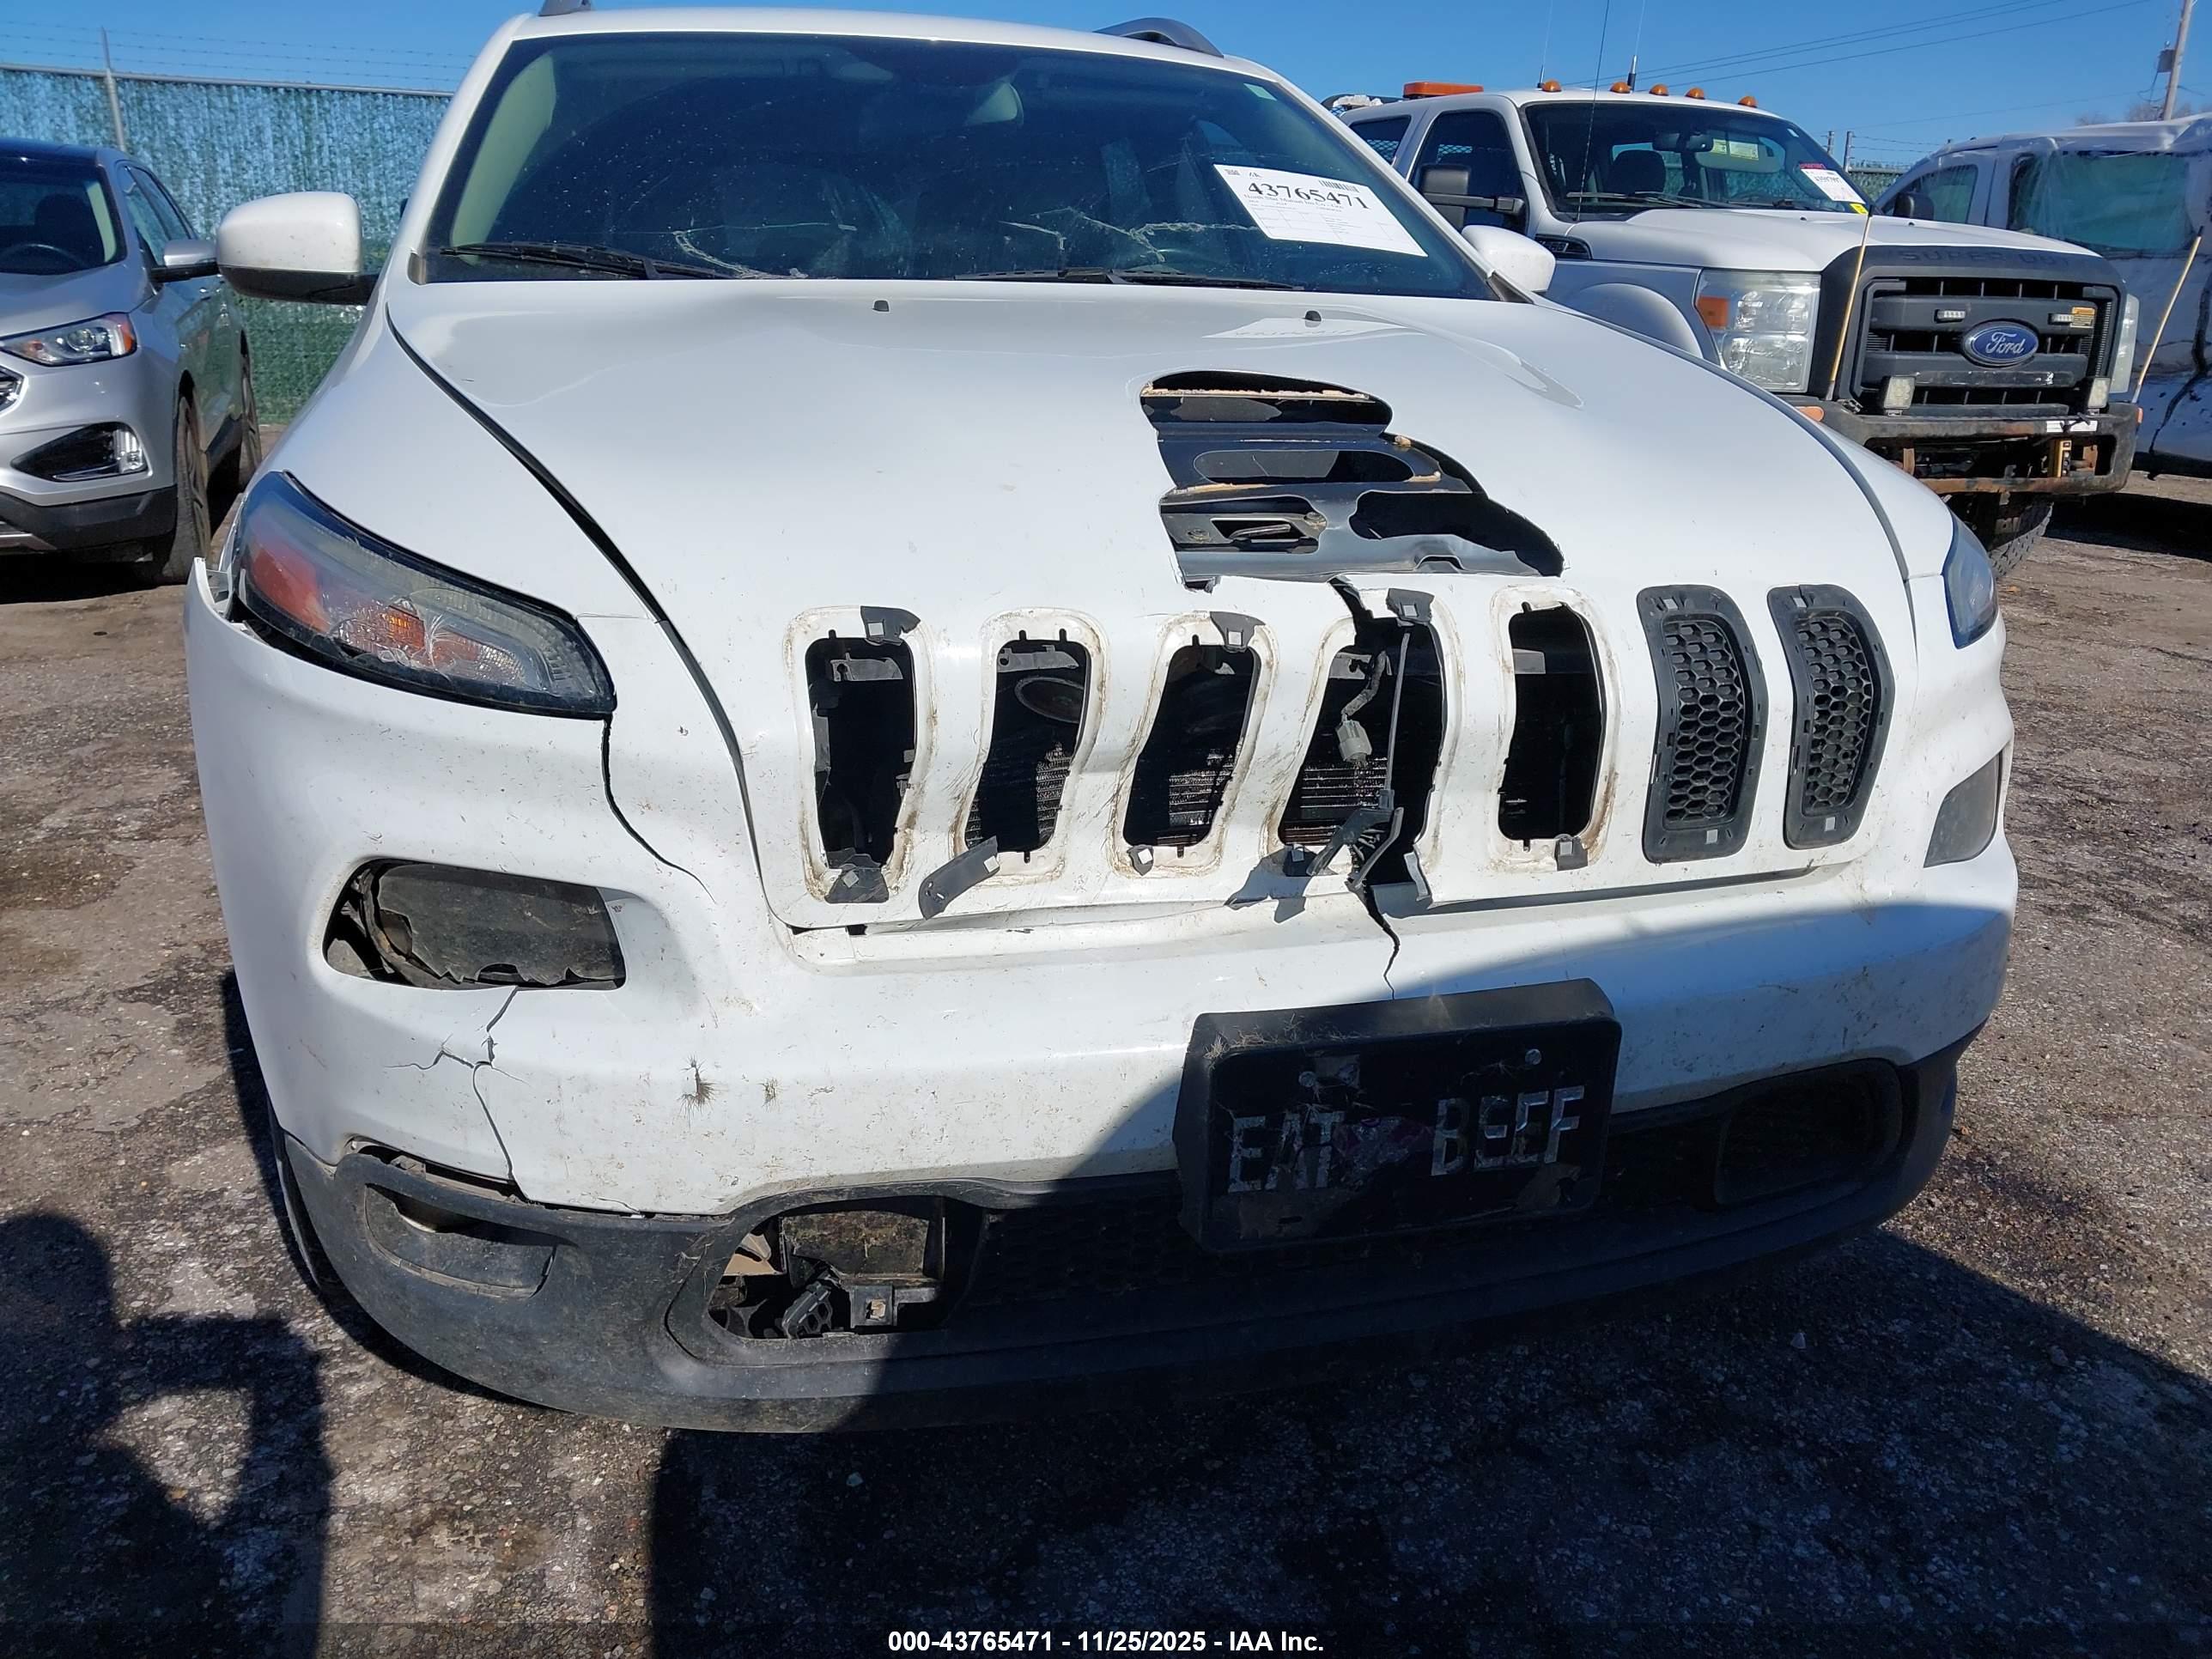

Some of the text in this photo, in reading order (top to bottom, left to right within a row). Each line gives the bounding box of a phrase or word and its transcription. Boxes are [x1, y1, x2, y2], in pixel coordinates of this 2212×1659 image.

[1249, 182, 1371, 210] 43765471
[1985, 331, 2025, 354] Ford
[1227, 1085, 1585, 1194] EAT BEEF
